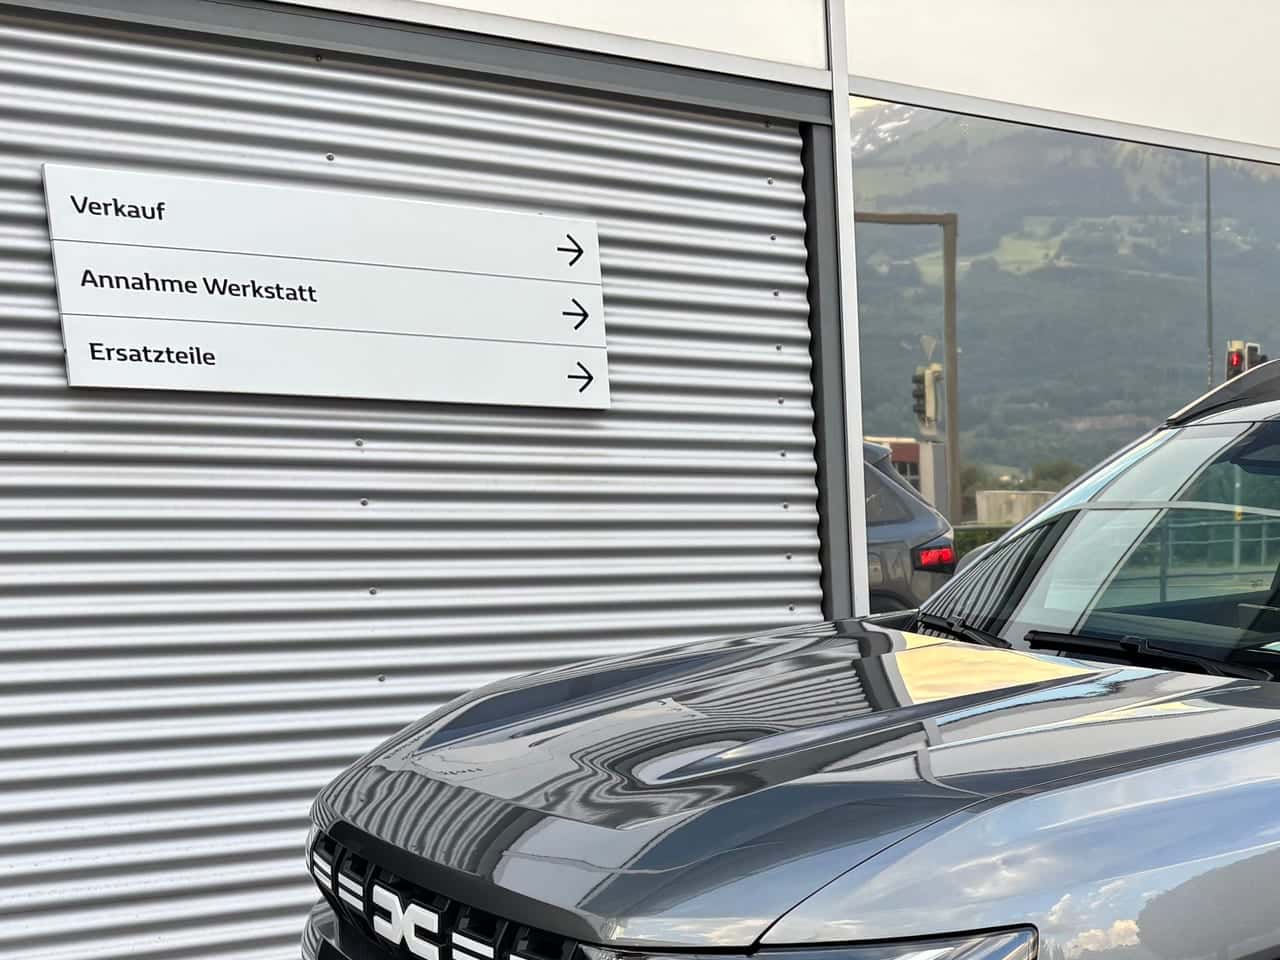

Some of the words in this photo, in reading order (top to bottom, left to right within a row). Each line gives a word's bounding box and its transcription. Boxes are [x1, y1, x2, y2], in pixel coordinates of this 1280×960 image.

[70, 195, 166, 221] Verkauf
[80, 269, 198, 295] Annahme
[202, 277, 318, 303] Werkstatt
[88, 342, 216, 366] Ersatzteile
